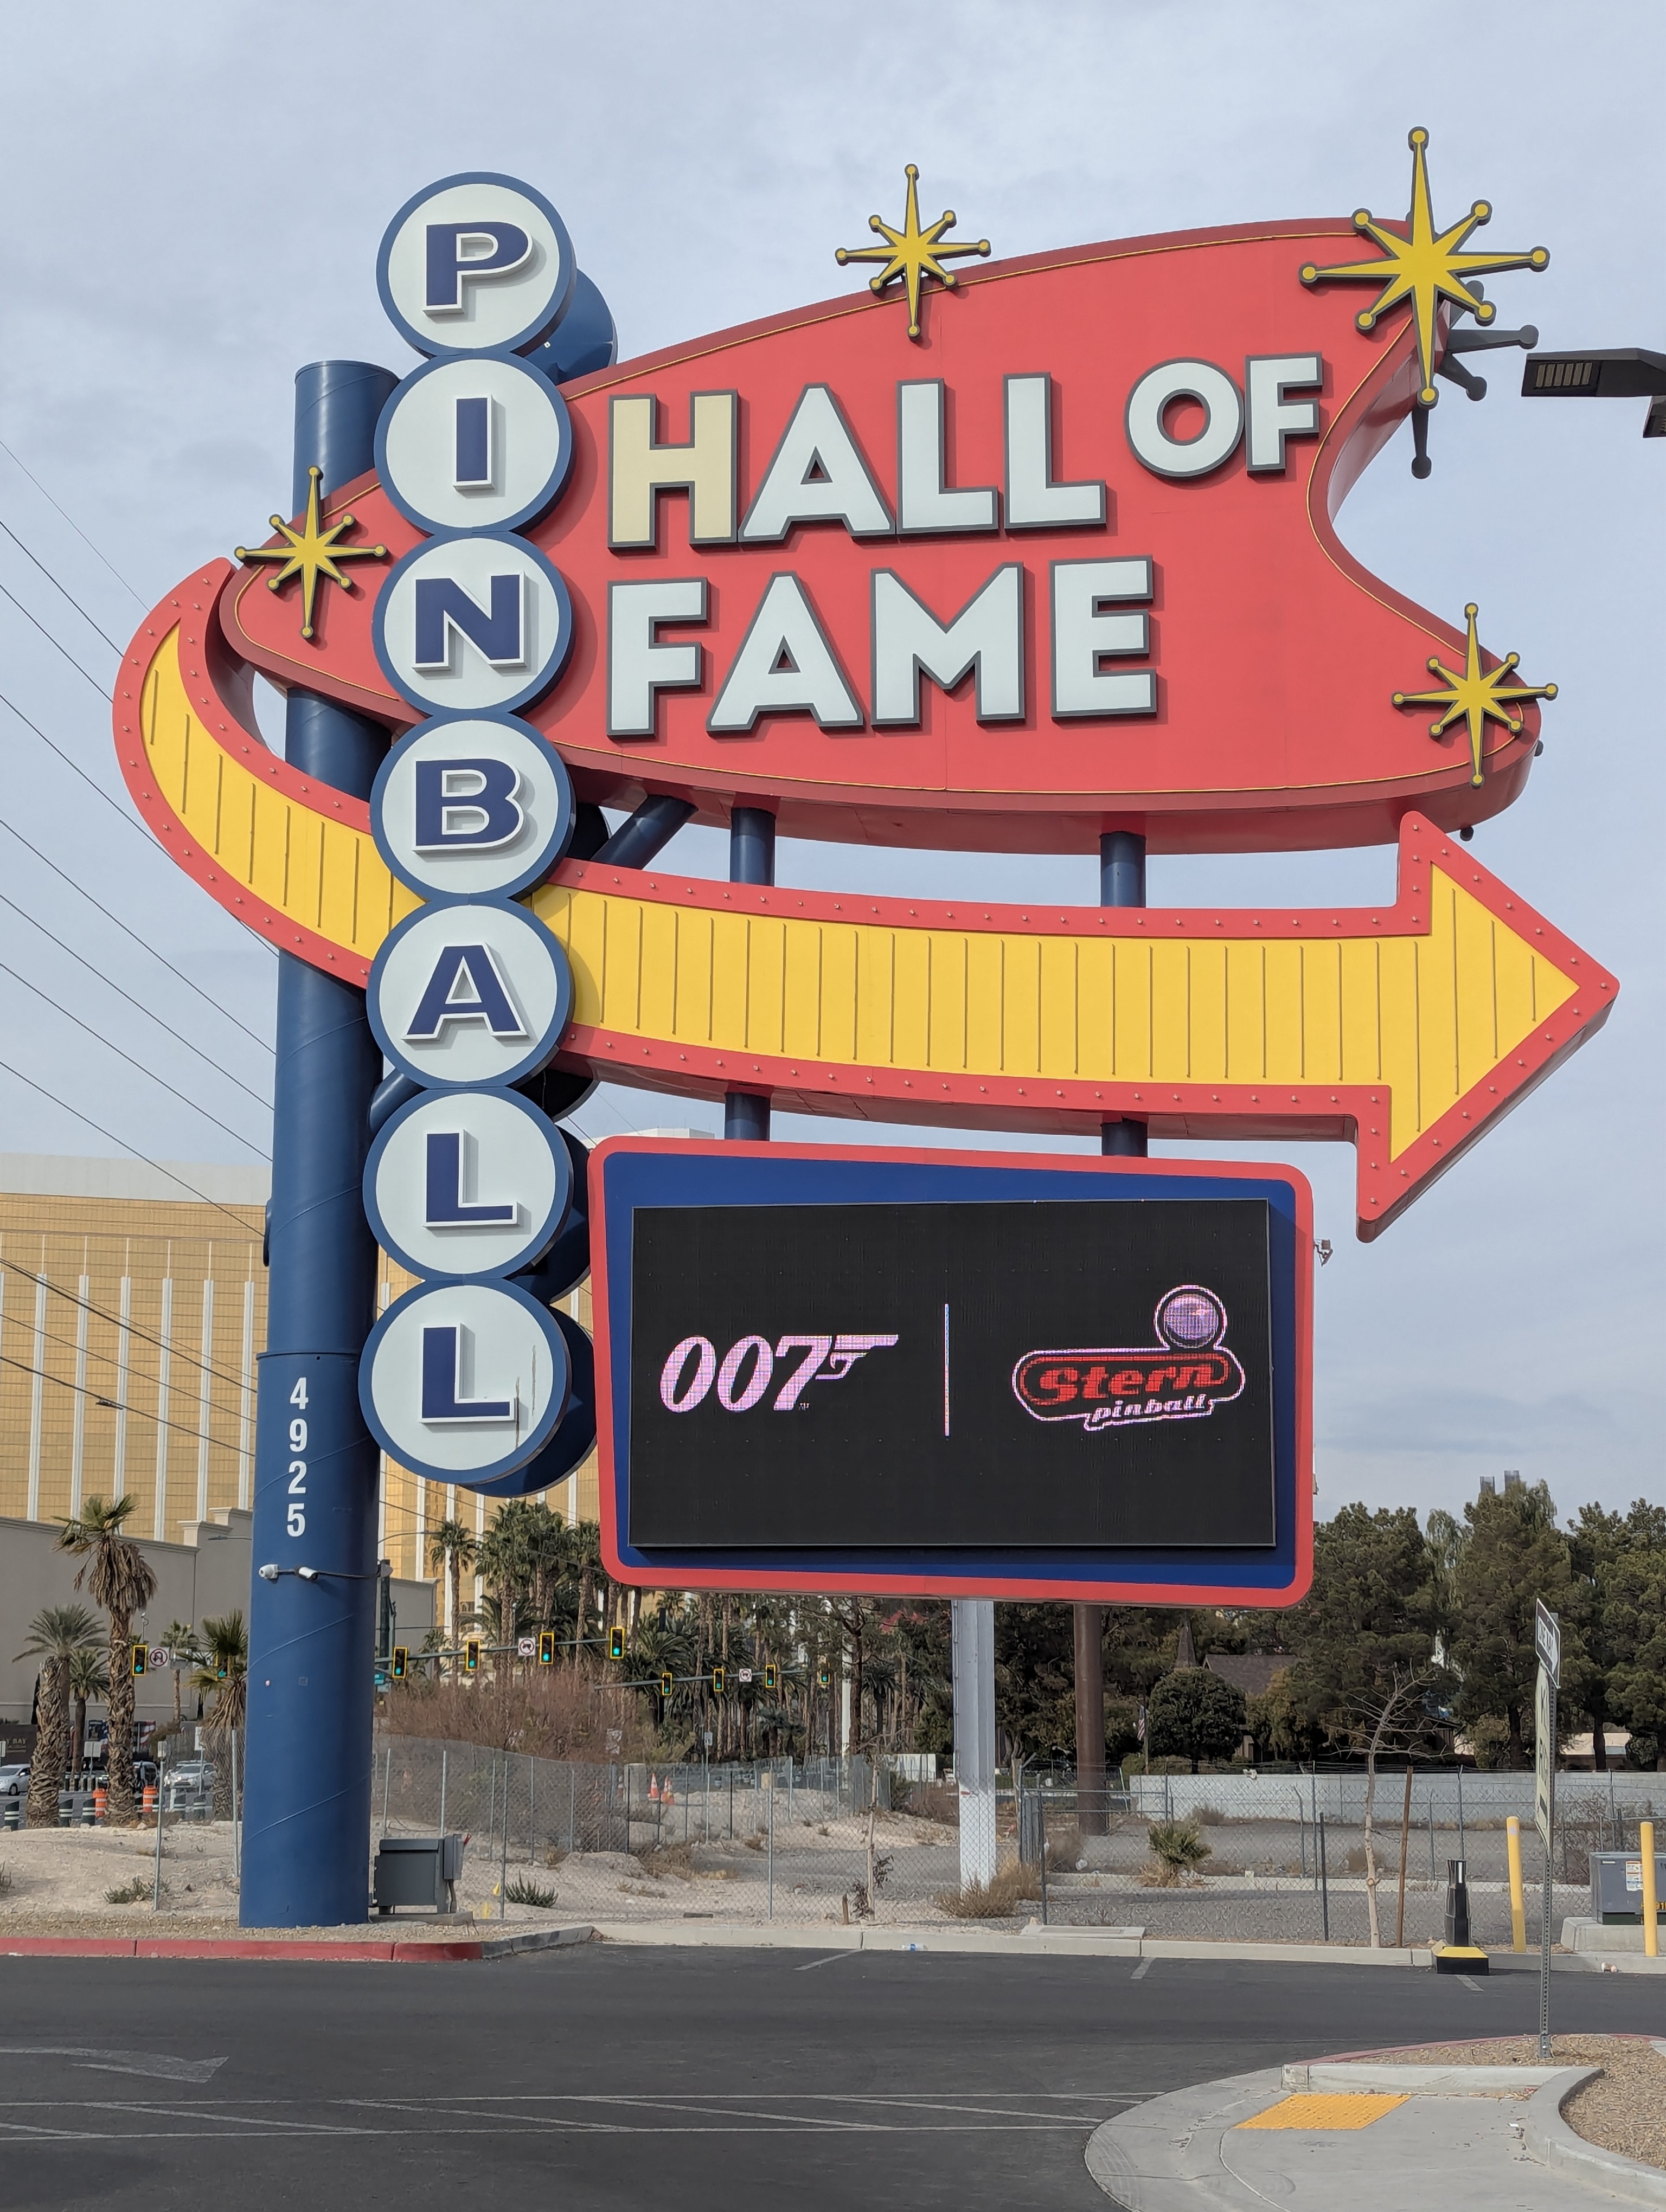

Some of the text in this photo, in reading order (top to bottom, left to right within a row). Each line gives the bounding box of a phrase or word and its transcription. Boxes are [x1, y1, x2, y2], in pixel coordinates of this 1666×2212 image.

[607, 352, 1323, 552] HALL OF
[606, 555, 1157, 739] FAME
[402, 221, 533, 1424] PINBALL
[659, 1334, 833, 1412] 007
[1038, 1365, 1215, 1405] Stern
[1091, 1393, 1207, 1423] pinball
[287, 1377, 309, 1537] 4925
